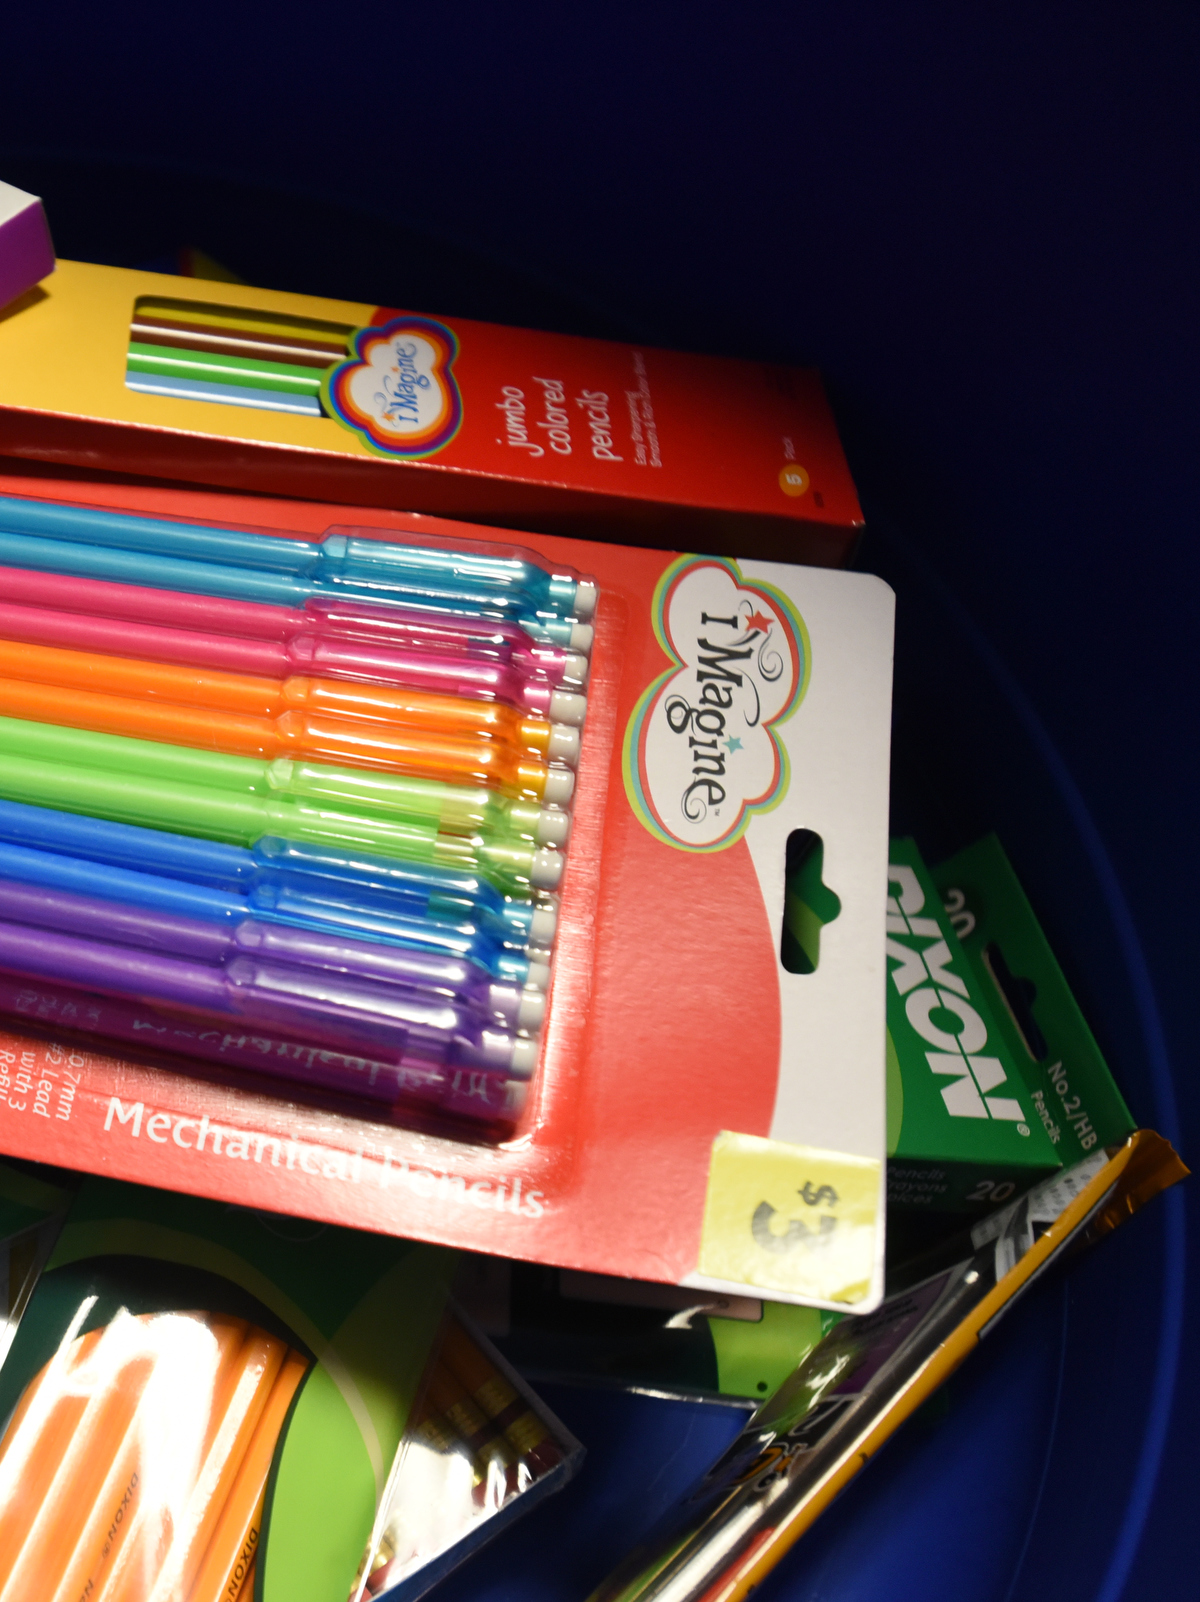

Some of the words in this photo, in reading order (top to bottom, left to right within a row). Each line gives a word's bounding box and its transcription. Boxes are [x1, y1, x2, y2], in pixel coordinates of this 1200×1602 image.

[383, 340, 431, 413] Magine
[495, 386, 545, 458] jumbo
[532, 376, 572, 455] colored
[575, 389, 624, 462] pencils
[785, 473, 802, 486] 5
[664, 636, 761, 824] Magine
[886, 864, 1027, 1122] DIXON
[14, 1051, 36, 1094] with
[45, 1043, 64, 1065] #2
[56, 1053, 84, 1120] 0.7mm
[8, 1096, 27, 1112] 3
[33, 1068, 59, 1118] Lead
[1031, 1089, 1060, 1145] Pencils
[1046, 1060, 1098, 1150] No.2/HB
[103, 1095, 363, 1185] Mechanical
[379, 1146, 546, 1219] Pencils
[964, 1179, 1016, 1203] 20
